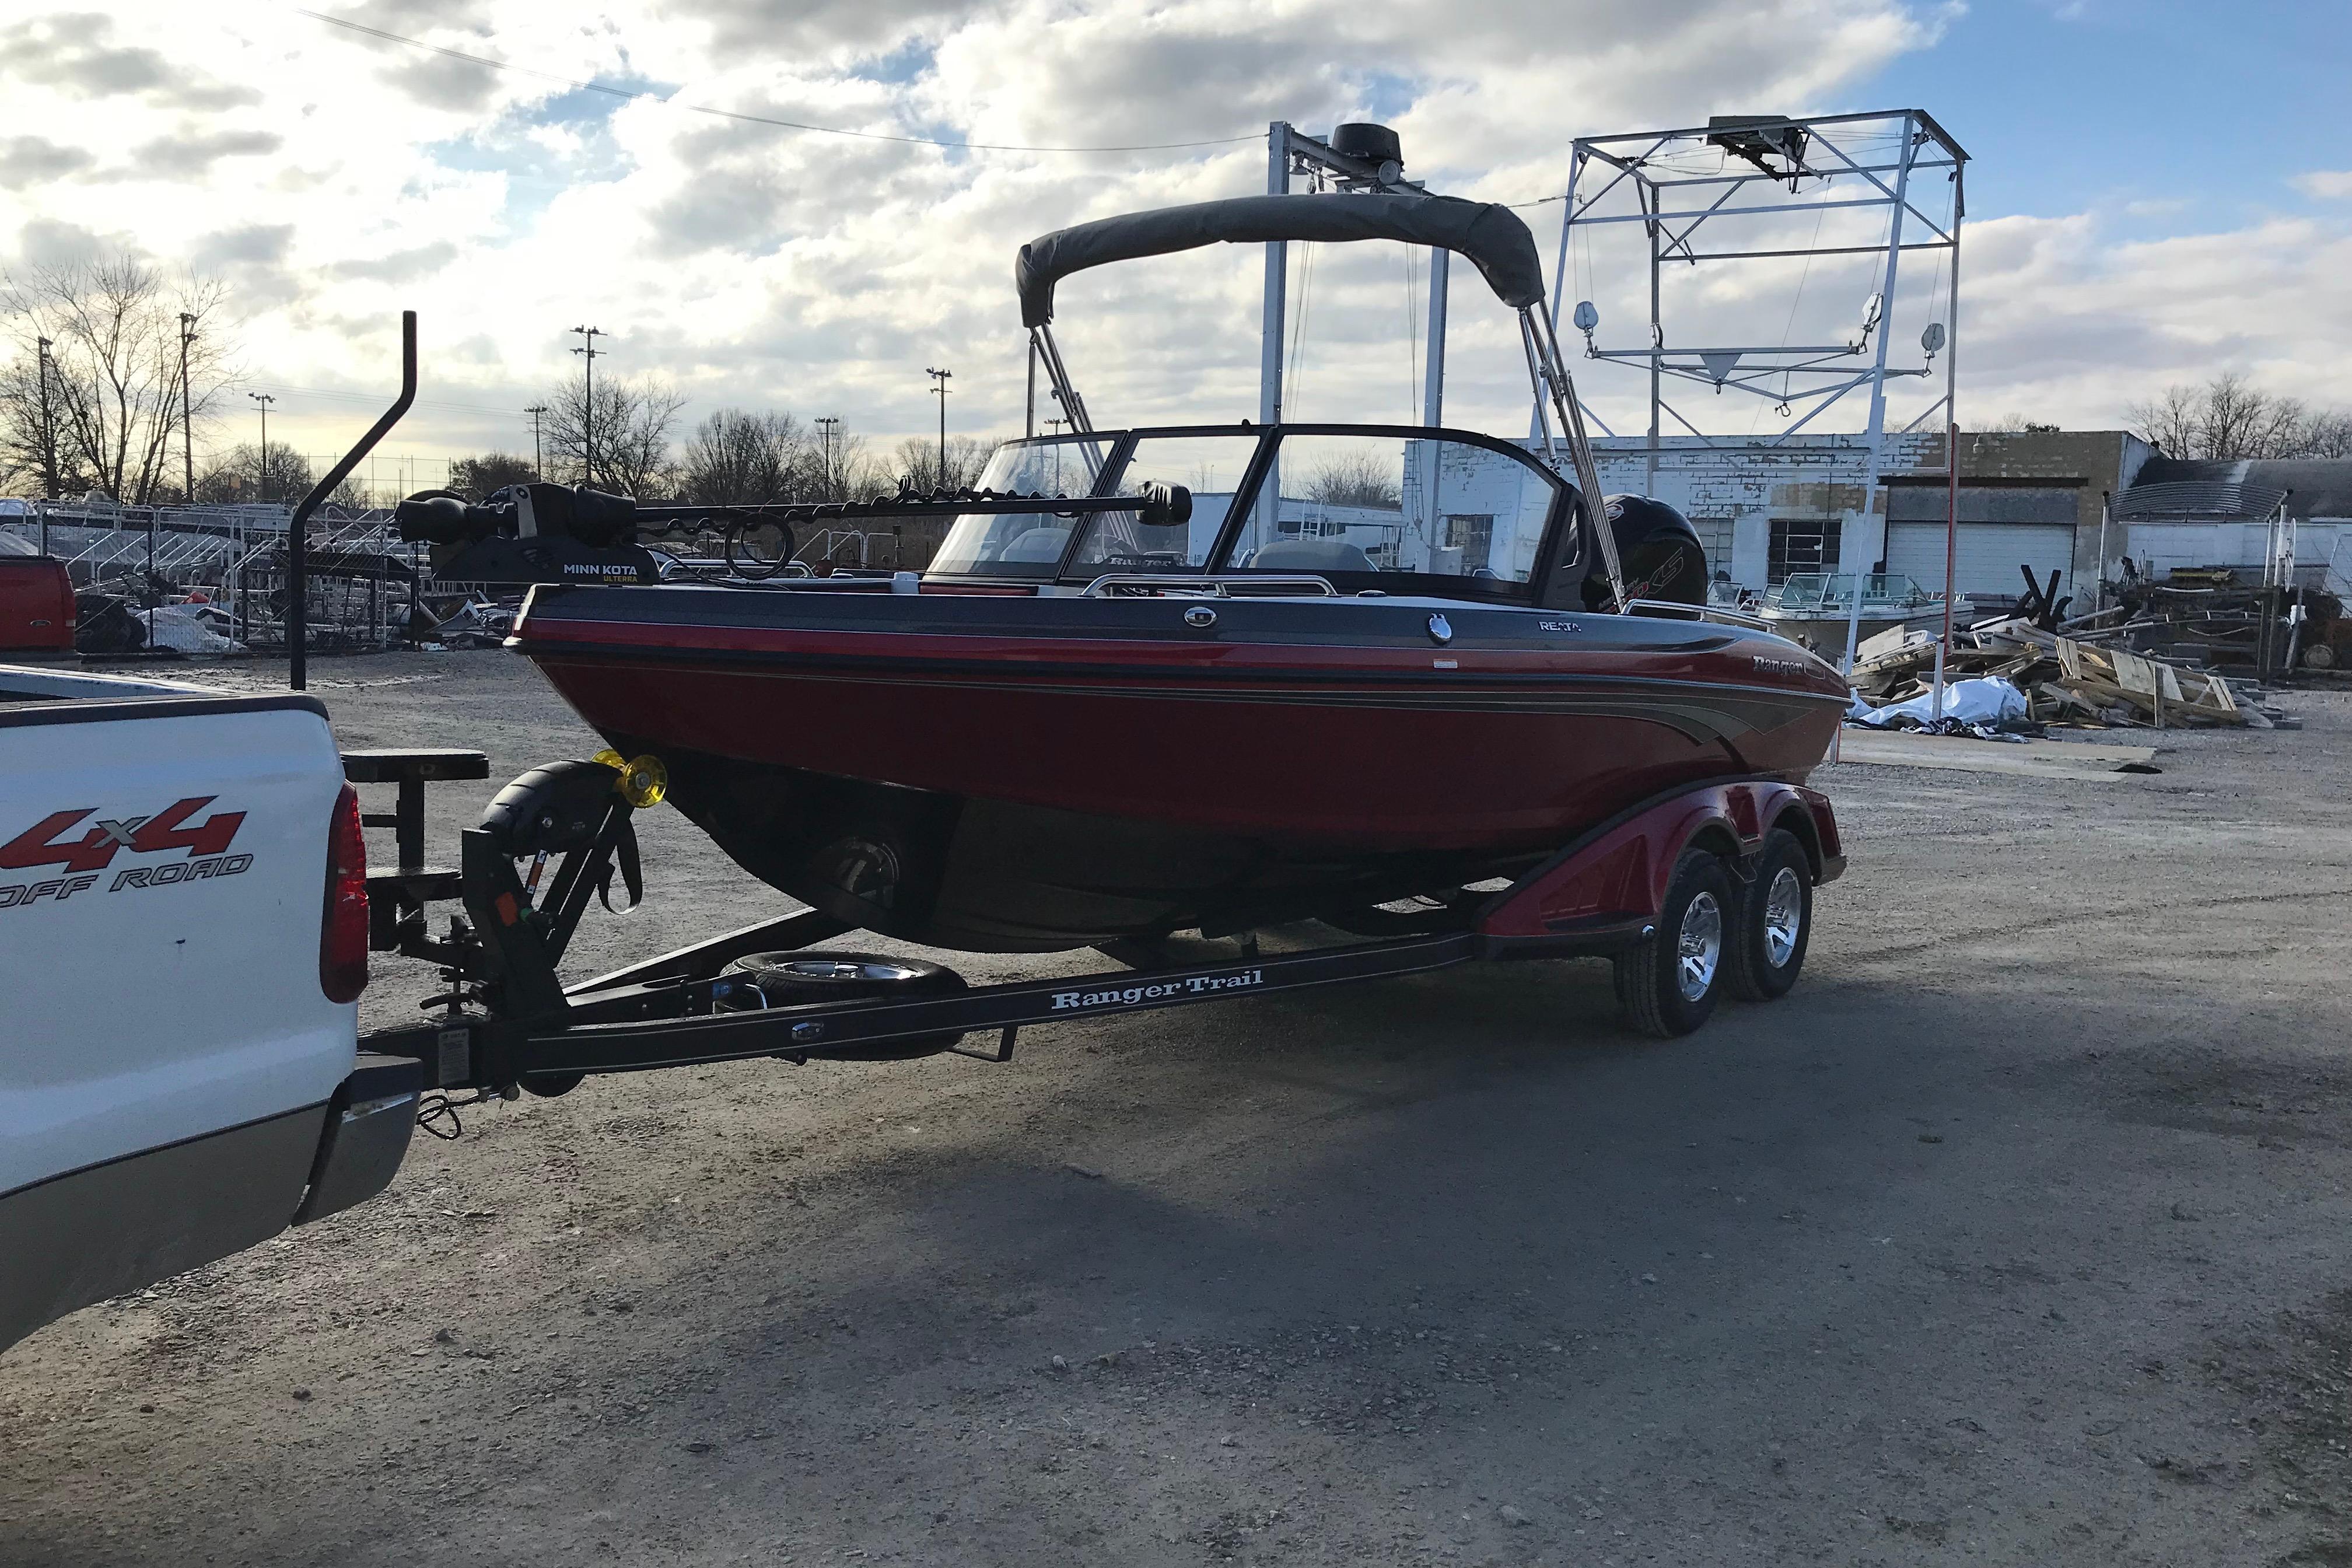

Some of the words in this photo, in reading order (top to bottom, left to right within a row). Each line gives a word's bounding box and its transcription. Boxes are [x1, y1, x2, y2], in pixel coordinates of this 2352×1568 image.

[564, 564, 600, 575] MINN
[603, 565, 638, 576] KOTA
[1538, 621, 1582, 632] REATA
[1752, 655, 1804, 677] Ranger
[0, 874, 99, 908] OFF
[109, 853, 254, 892] ROAD
[1051, 982, 1181, 1010] Ranger
[1186, 970, 1264, 993] Trail
